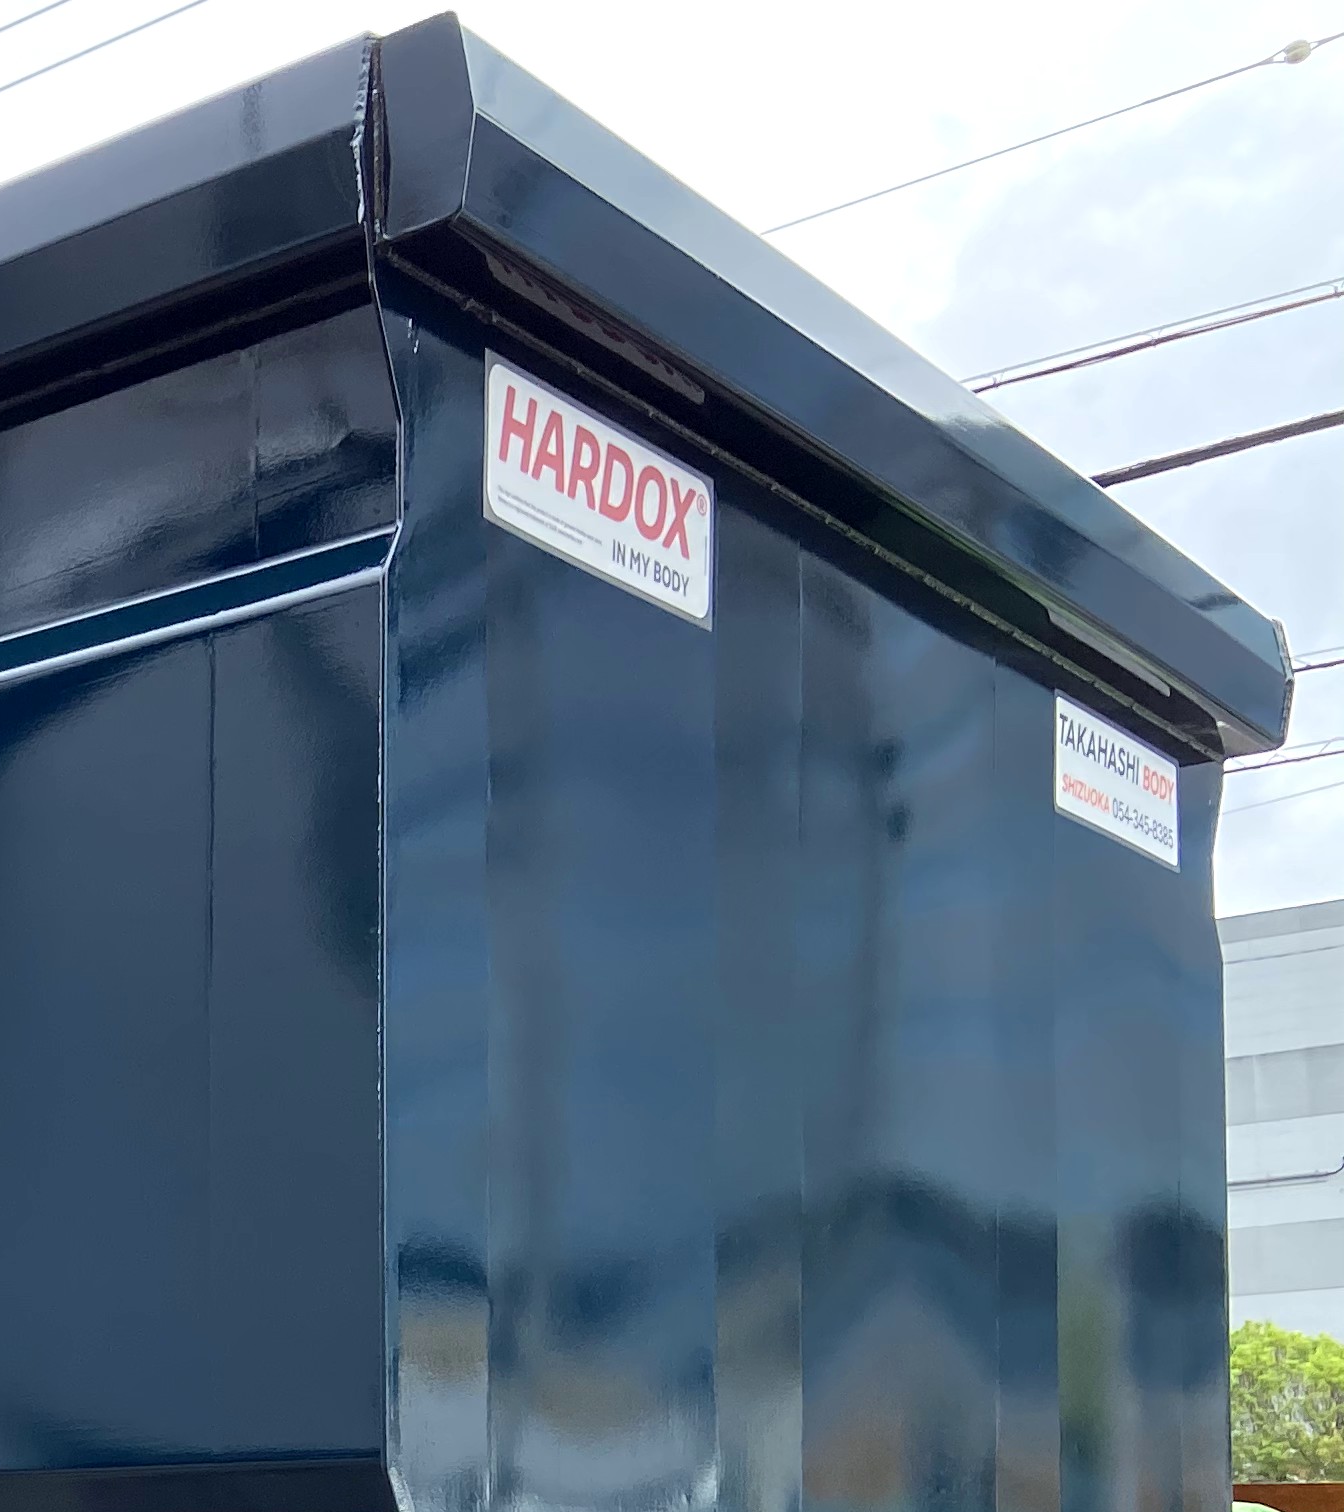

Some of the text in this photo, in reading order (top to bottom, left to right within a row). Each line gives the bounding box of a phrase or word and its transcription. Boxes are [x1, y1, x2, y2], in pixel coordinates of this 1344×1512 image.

[612, 538, 690, 597] IN MY BODY
[1059, 712, 1175, 806] TAKAHASHI BODY
[1061, 773, 1110, 814] SHIZUOKA
